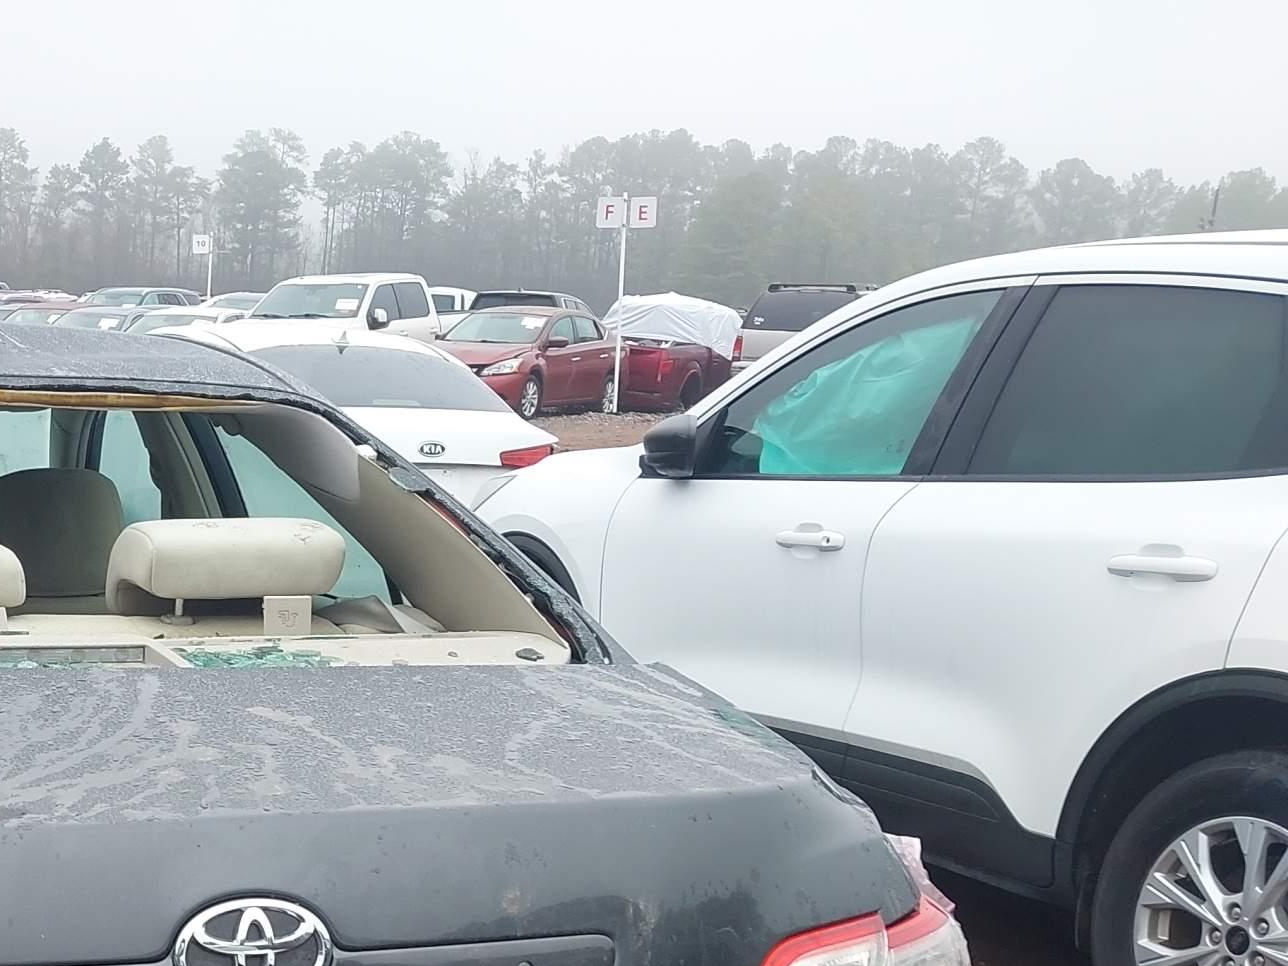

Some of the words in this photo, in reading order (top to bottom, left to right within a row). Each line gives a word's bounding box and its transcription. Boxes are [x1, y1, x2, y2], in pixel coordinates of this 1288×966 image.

[605, 204, 615, 221] F
[638, 205, 649, 221] E
[423, 444, 442, 454] KIA
